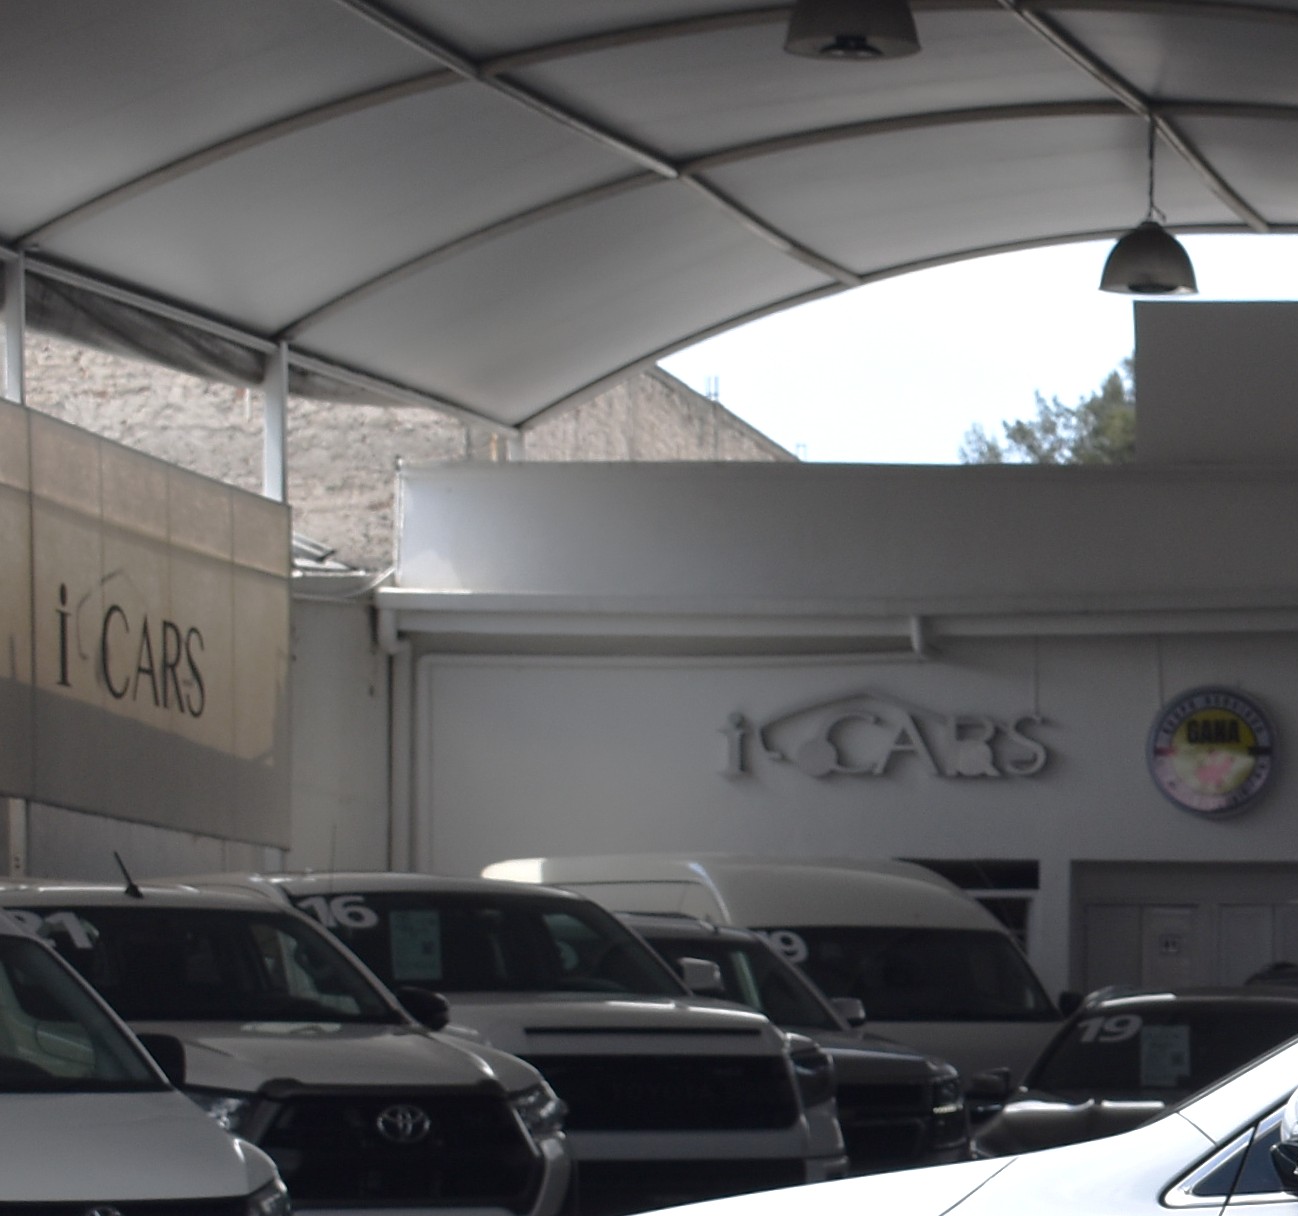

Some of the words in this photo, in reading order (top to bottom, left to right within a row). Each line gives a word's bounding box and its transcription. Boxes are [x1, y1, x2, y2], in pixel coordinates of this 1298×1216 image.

[101, 603, 206, 719] CARS
[818, 710, 1049, 778] CARS
[1077, 1013, 1143, 1044] 19
